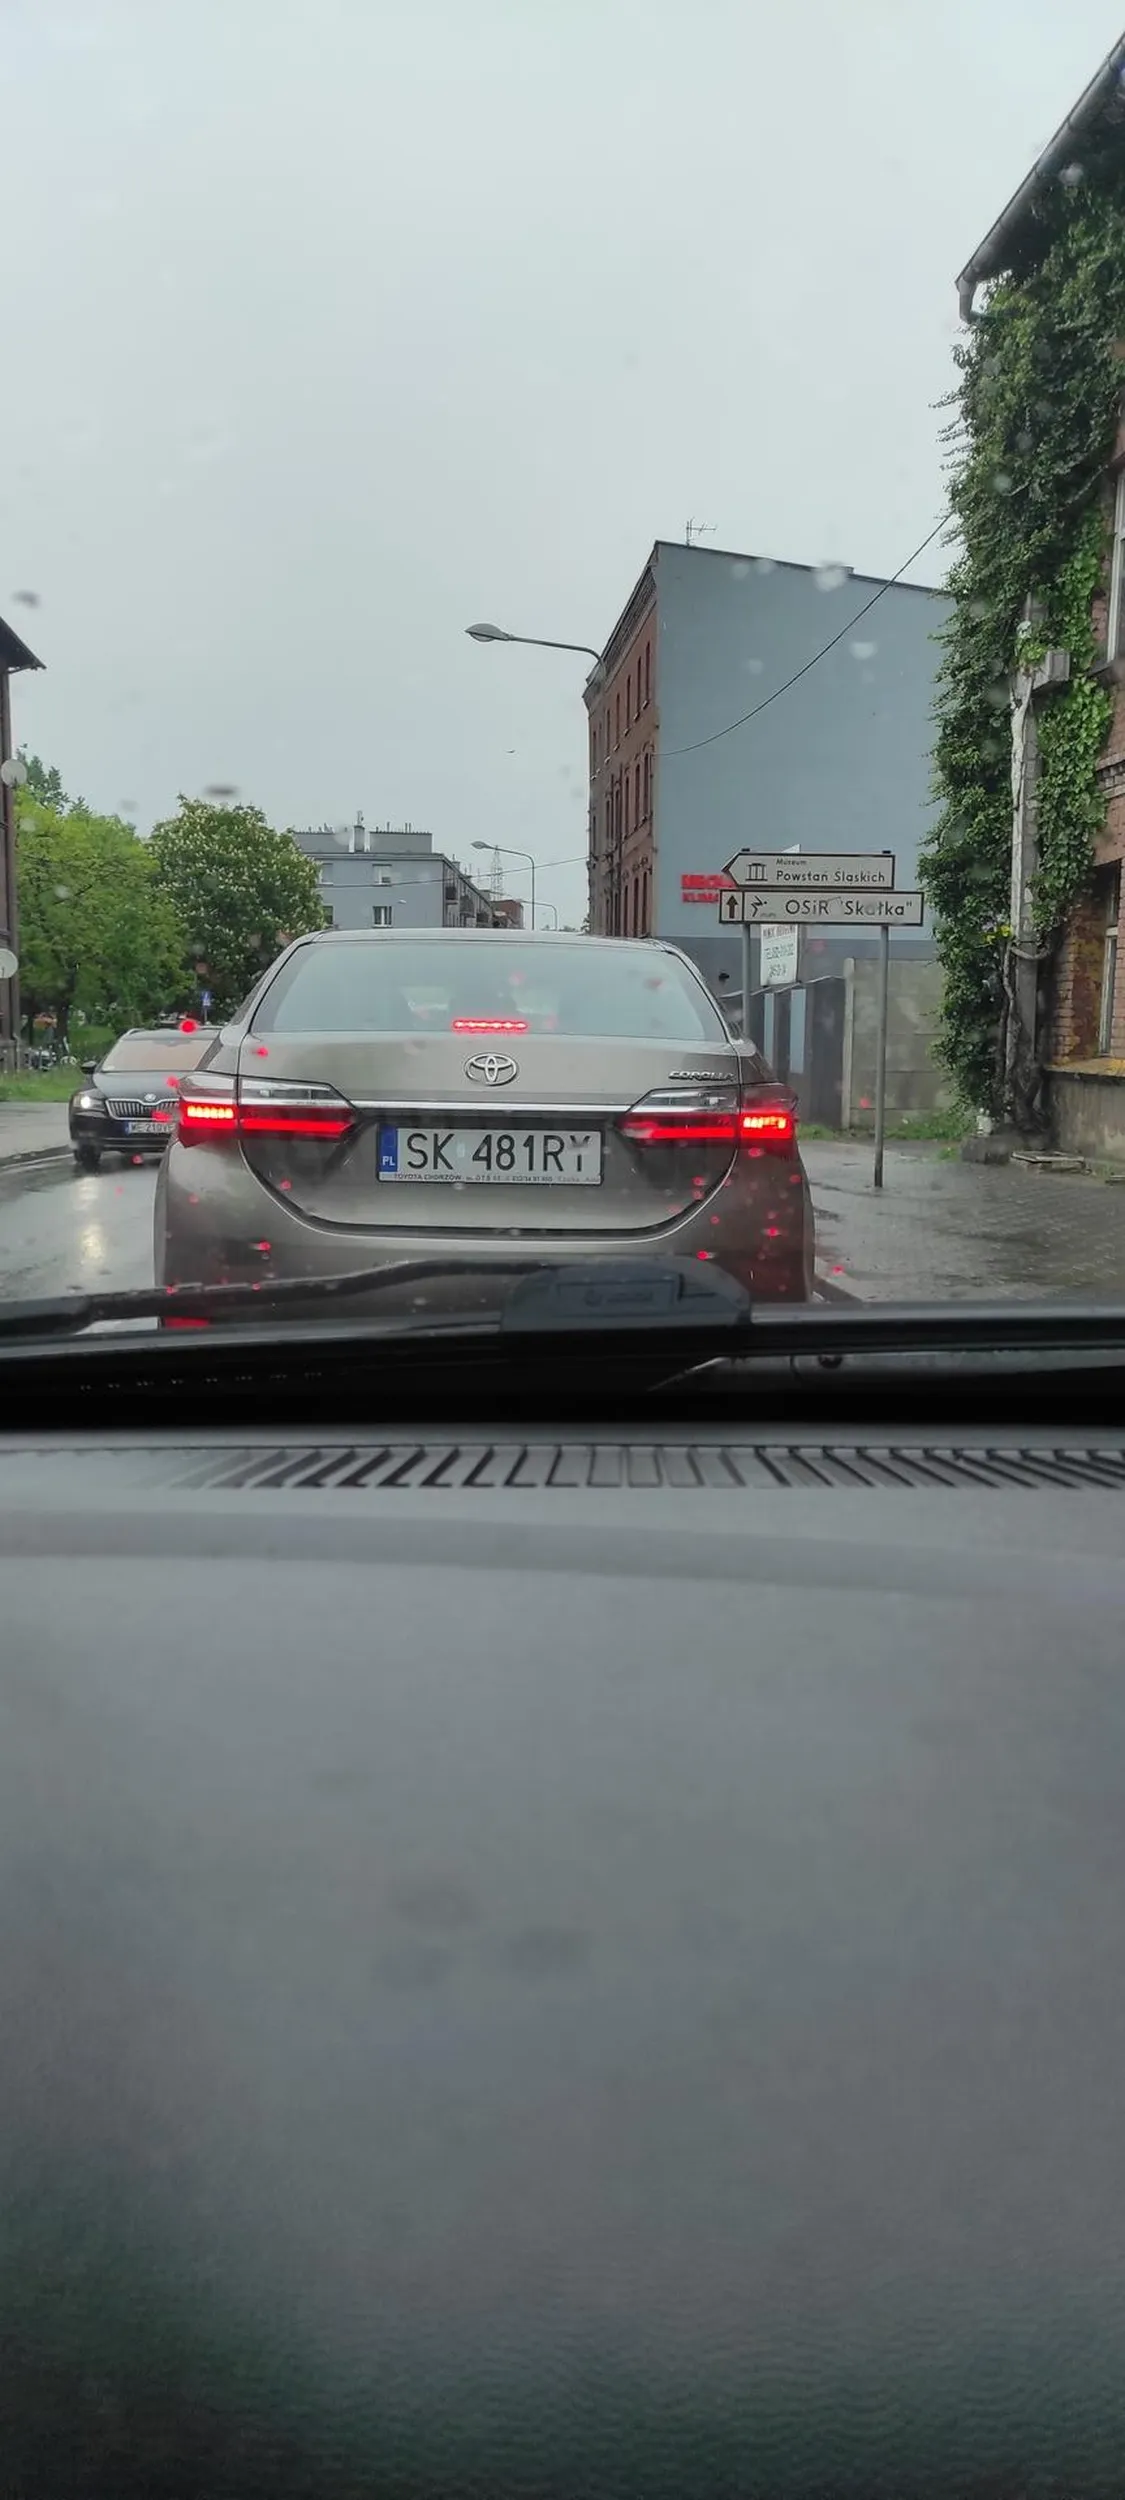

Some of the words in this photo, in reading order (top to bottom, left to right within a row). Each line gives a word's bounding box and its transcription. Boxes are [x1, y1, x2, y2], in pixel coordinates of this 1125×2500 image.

[785, 899, 829, 916] OSiR
[407, 1132, 455, 1170] SK
[472, 1134, 591, 1172] 481RY
[382, 1156, 396, 1166] PL
